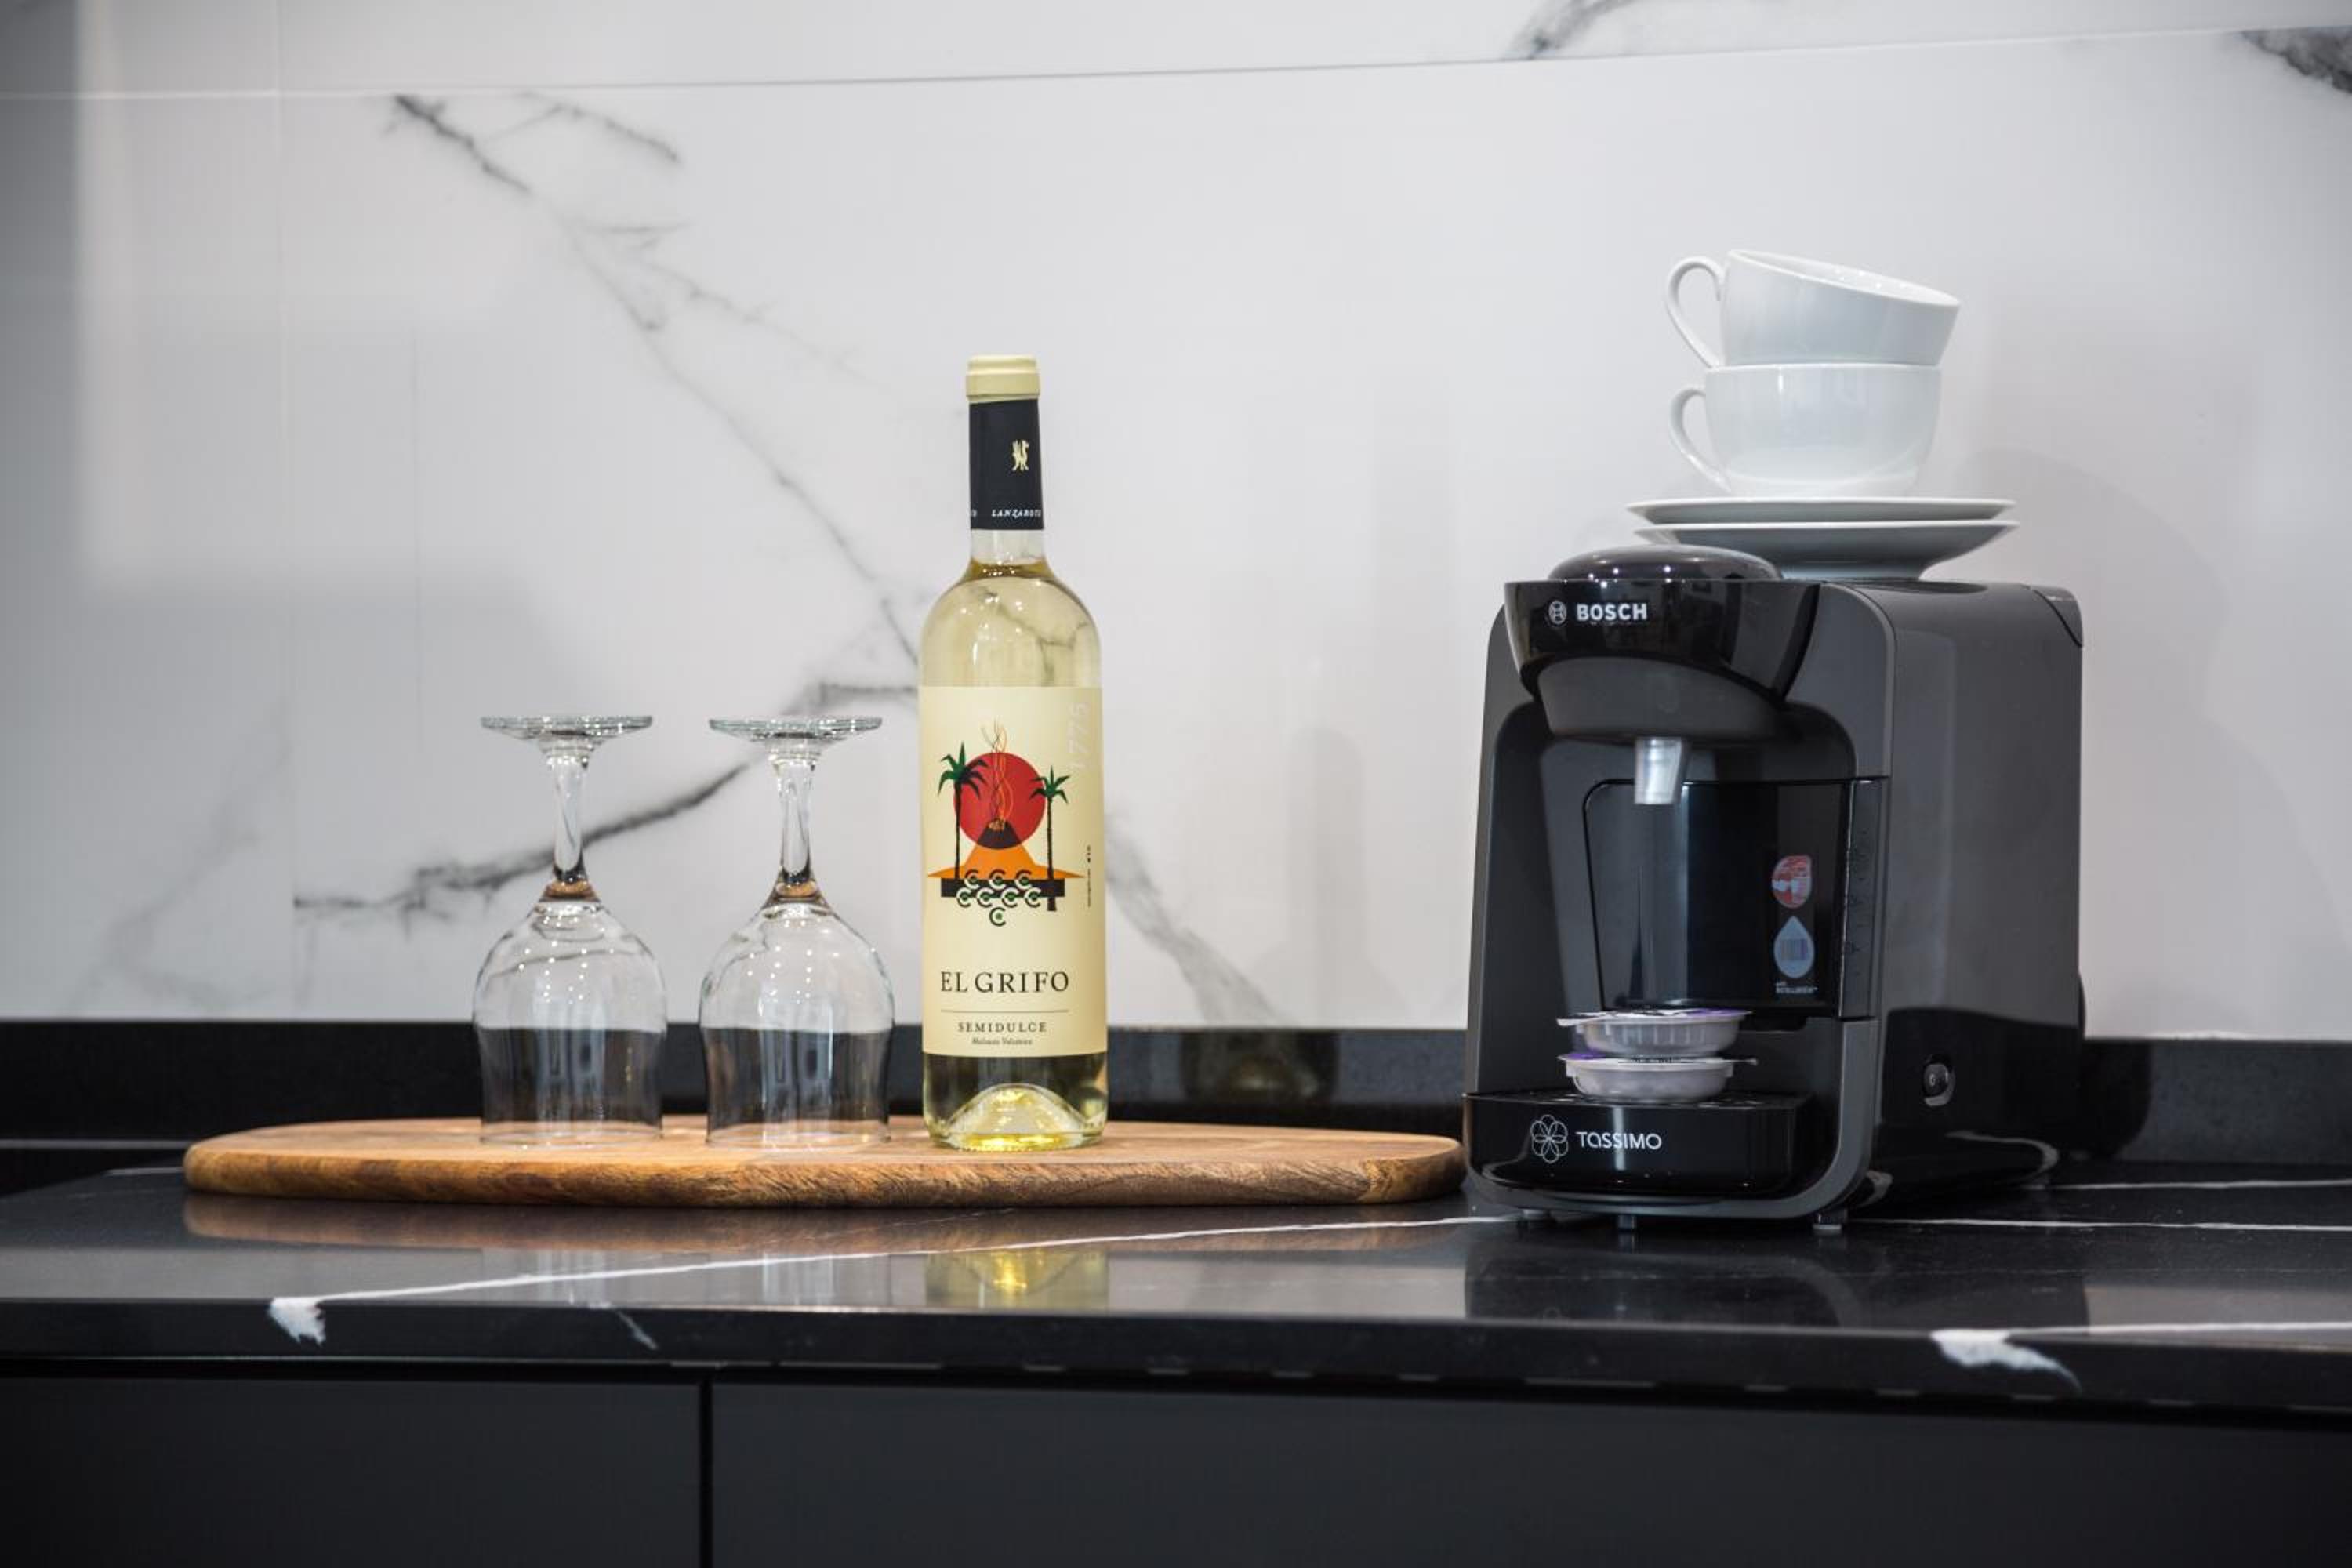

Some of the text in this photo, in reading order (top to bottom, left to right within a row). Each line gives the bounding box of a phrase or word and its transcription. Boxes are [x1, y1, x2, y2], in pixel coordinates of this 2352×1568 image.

[1577, 603, 1647, 622] BOSCH
[941, 971, 1069, 993] EL GRIFO
[957, 1022, 1047, 1033] SEMIDULCE
